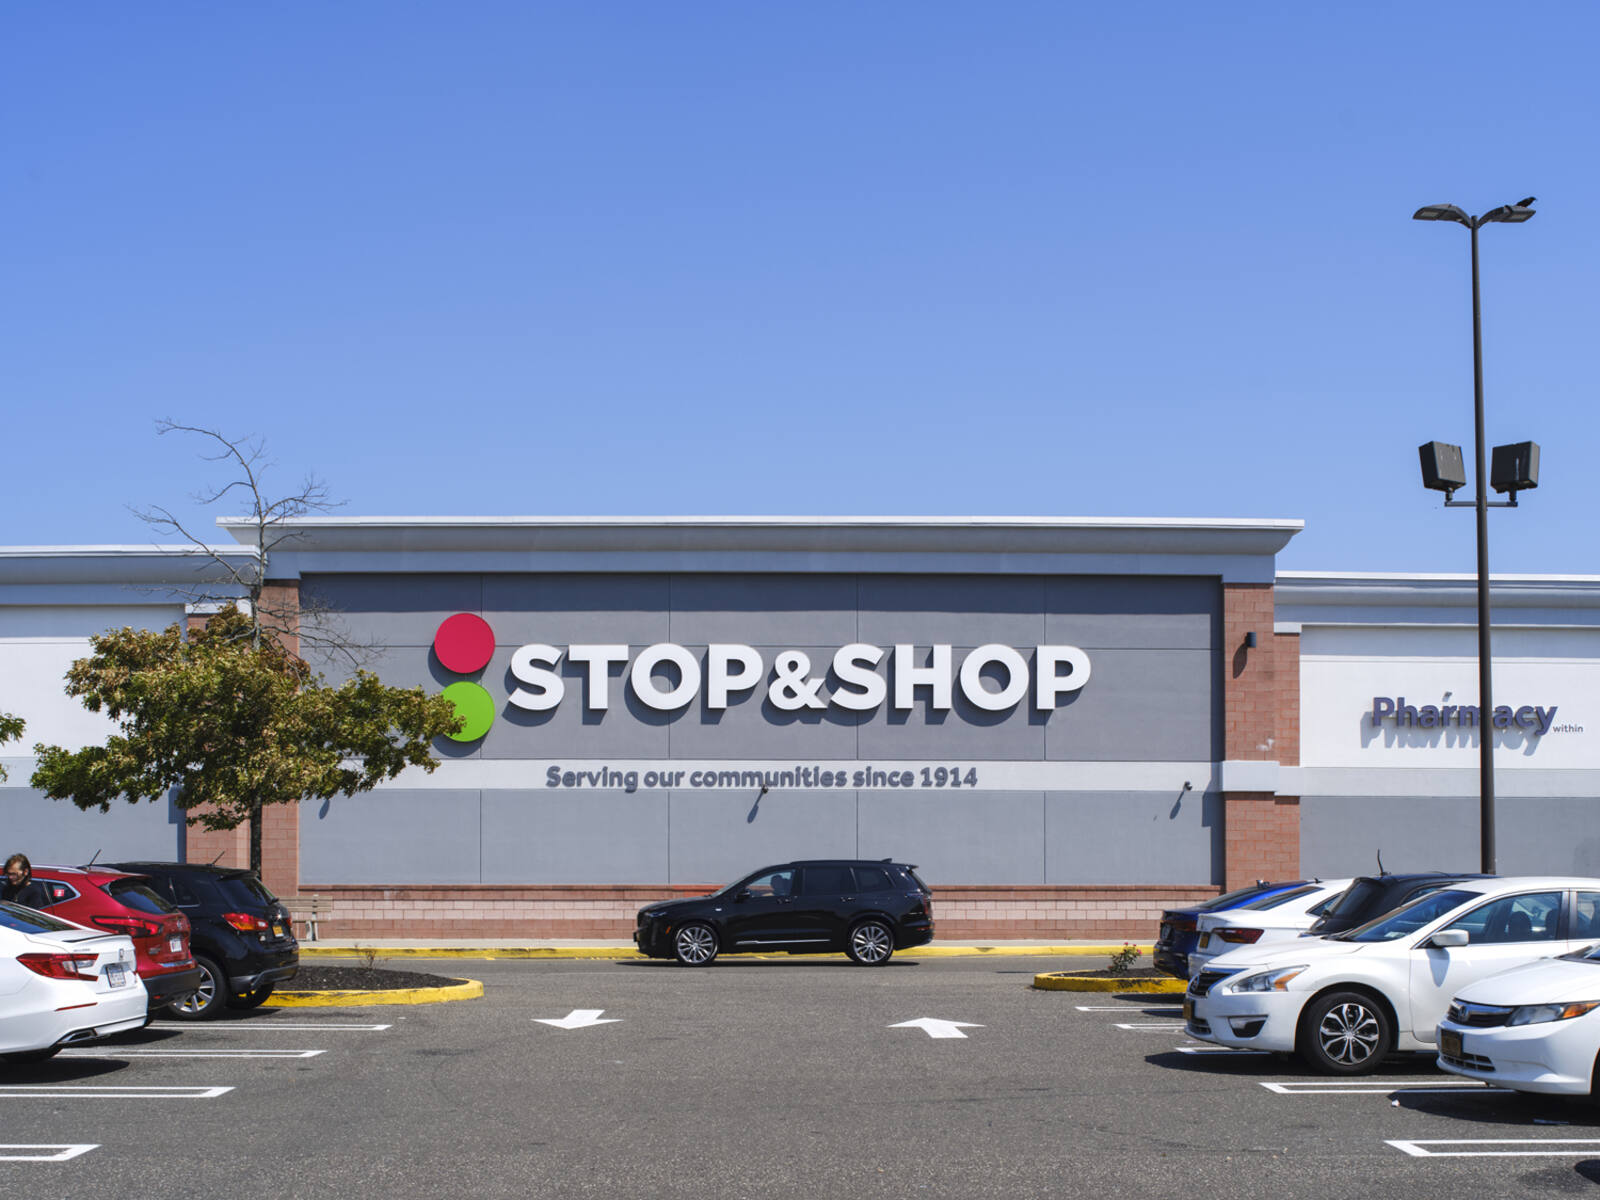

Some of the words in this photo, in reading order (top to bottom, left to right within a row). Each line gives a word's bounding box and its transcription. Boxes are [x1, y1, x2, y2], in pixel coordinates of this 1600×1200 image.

[508, 643, 1091, 711] STOP&SHOP
[1553, 724, 1584, 733] within
[546, 765, 639, 793] Serving
[643, 770, 686, 788] our
[690, 766, 848, 788] communities
[852, 766, 915, 788] since
[920, 767, 978, 788] 1914
